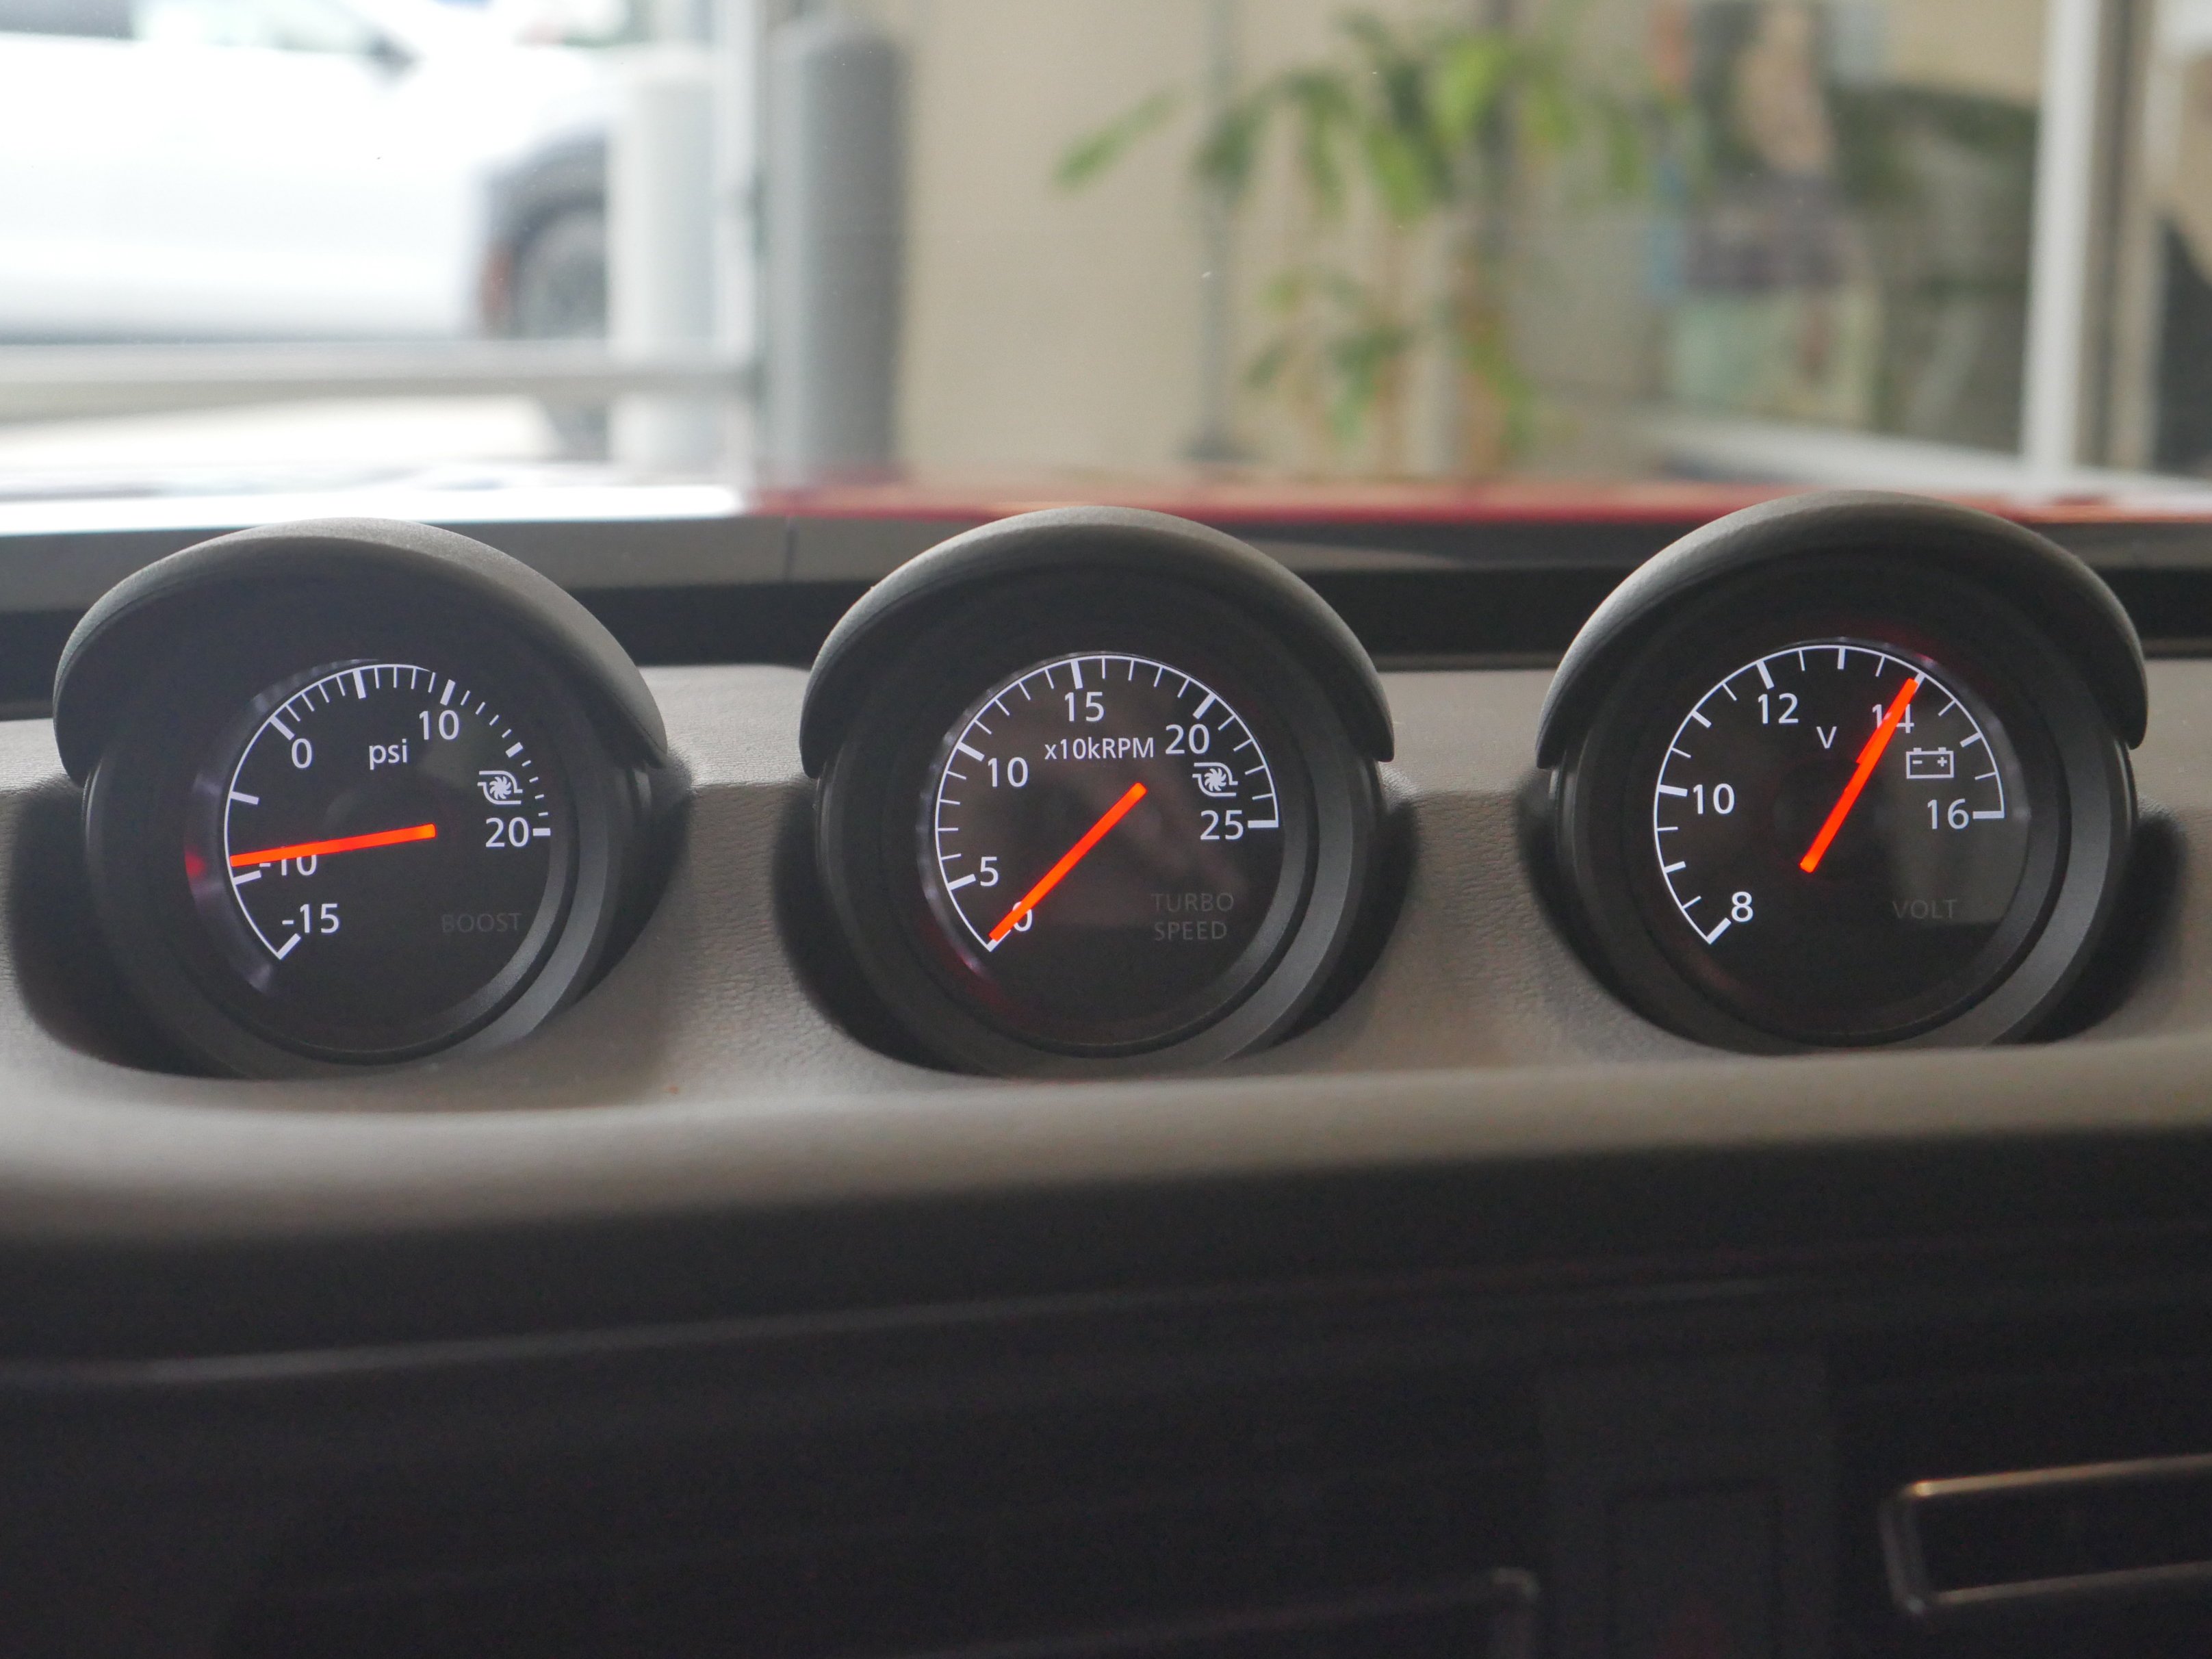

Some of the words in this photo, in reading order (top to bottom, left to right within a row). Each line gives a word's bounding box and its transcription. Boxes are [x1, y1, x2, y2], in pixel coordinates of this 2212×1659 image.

[1064, 691, 1105, 723] 15
[1757, 692, 1799, 725] 12
[419, 710, 460, 741] 10
[1165, 723, 1210, 755] 20
[1816, 725, 1838, 749] V
[291, 737, 313, 769] 0
[368, 738, 409, 771] psi
[1044, 736, 1155, 761] x10kRPM
[987, 756, 1029, 788] 10
[1692, 782, 1736, 815] 10
[1927, 798, 1970, 830] 16
[485, 817, 529, 848] 20
[1199, 810, 1244, 841] 25
[979, 856, 999, 887] 5
[1150, 892, 1235, 913] TURBO
[1730, 890, 1754, 923] 8
[1892, 898, 1959, 920] VOLT
[281, 903, 339, 934] -15
[441, 912, 522, 934] BOOST
[1153, 921, 1228, 941] SPEED
